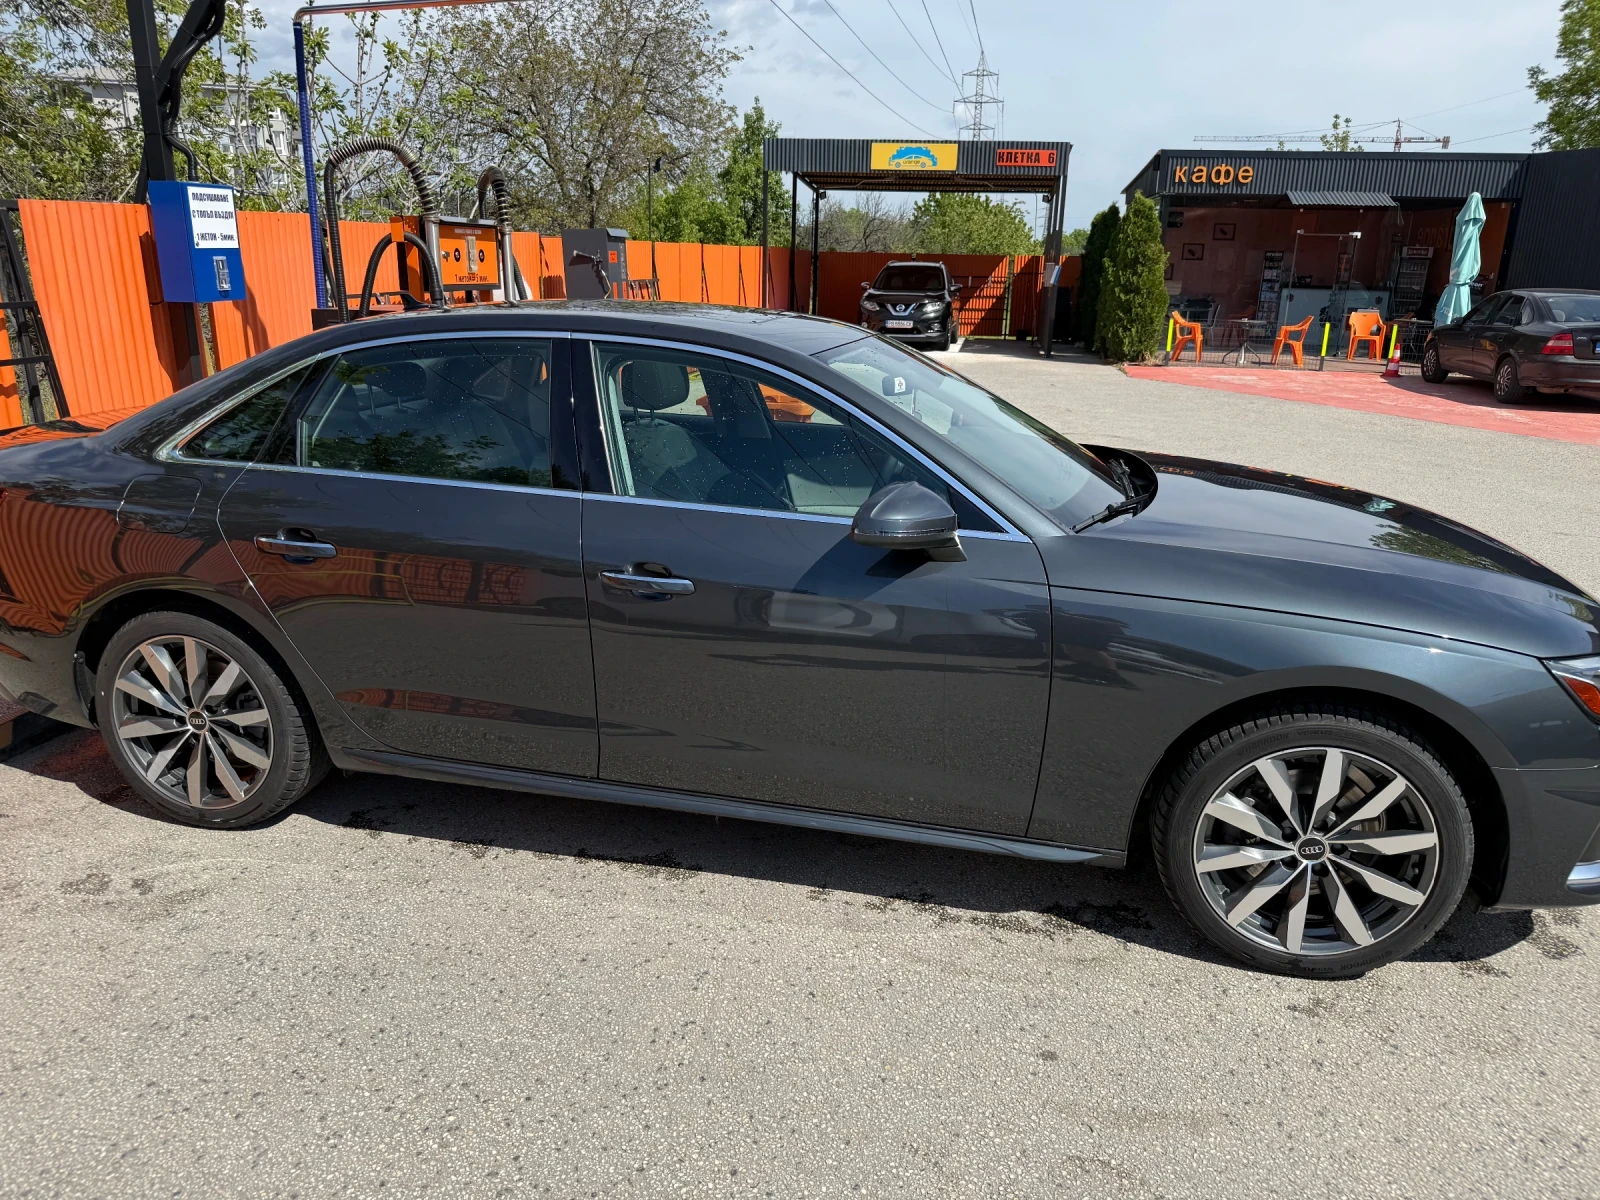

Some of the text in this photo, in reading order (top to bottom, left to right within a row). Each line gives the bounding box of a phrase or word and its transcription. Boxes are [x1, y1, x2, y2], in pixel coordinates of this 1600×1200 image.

[997, 151, 1055, 164] КЛЕТКА 6
[1174, 163, 1254, 186] кафе
[192, 192, 229, 203] ПОДСУШАВАНЕ
[191, 209, 196, 219] С
[214, 210, 235, 220] ВЪЗДУХ
[196, 232, 200, 241] 1
[200, 232, 218, 242] ЖЕТОН
